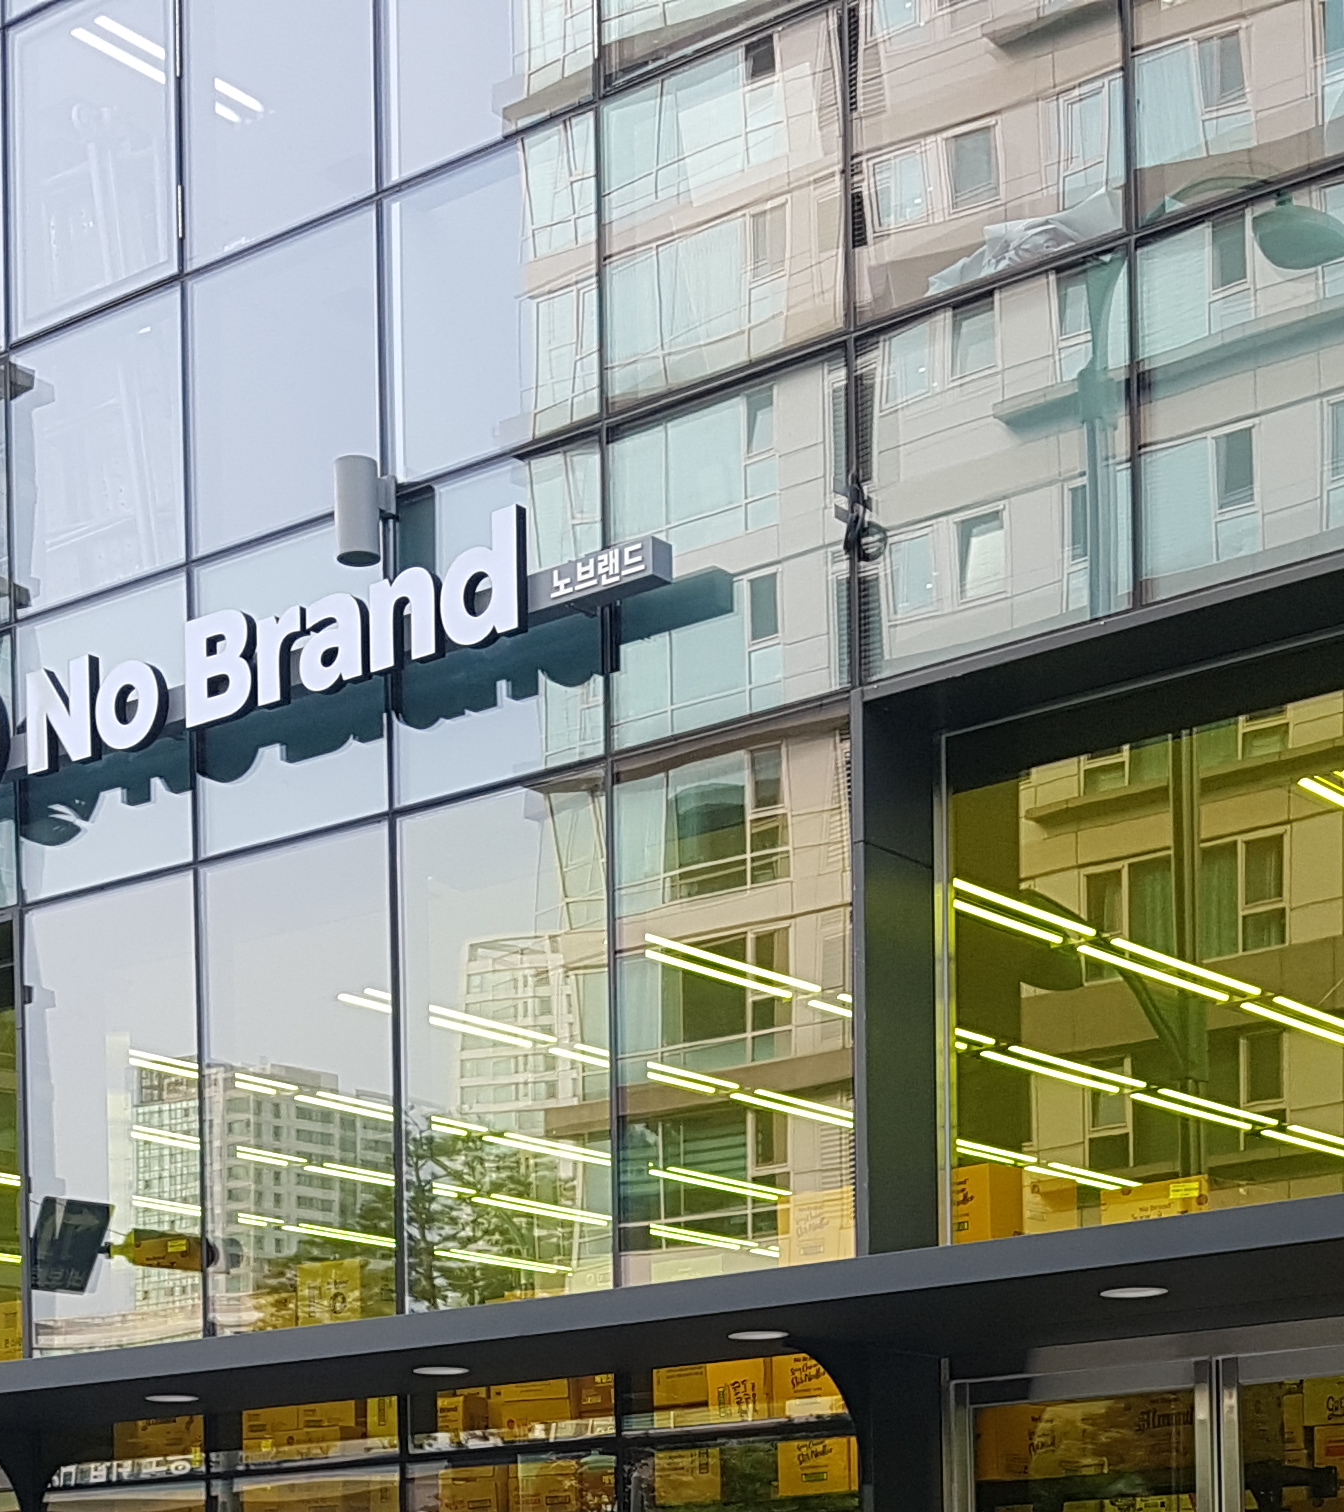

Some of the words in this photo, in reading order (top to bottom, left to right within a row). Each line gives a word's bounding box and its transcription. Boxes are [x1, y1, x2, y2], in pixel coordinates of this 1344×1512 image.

[26, 655, 166, 775] No
[185, 503, 525, 730] Brand
[549, 541, 648, 602] 노브랜드
